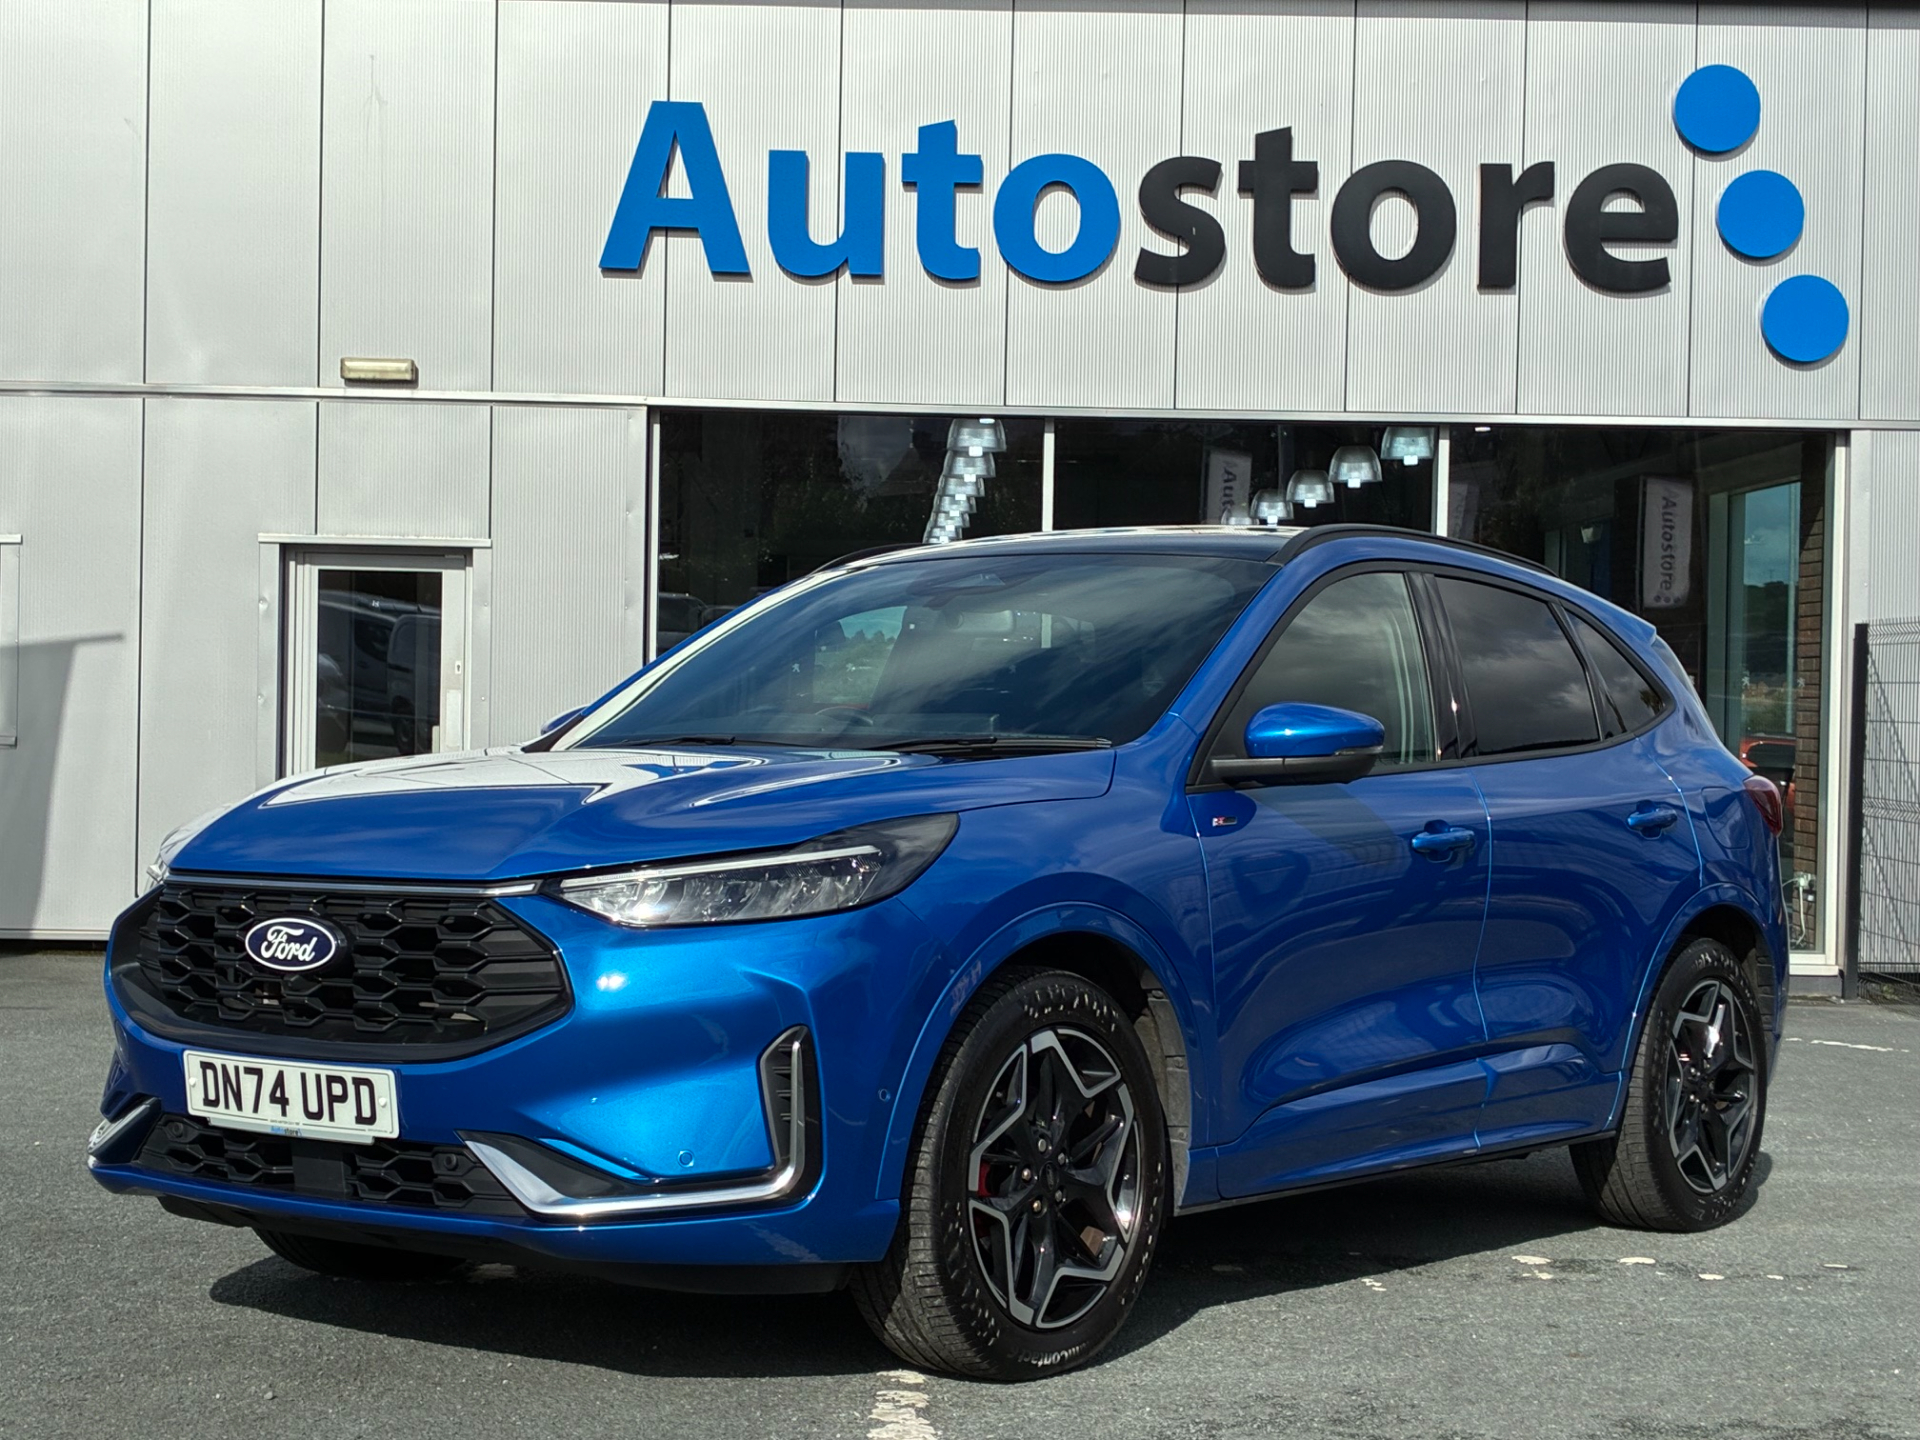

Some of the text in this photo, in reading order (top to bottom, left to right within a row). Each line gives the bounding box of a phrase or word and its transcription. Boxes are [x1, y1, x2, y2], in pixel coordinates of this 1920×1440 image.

[599, 100, 1680, 293] Autostore
[1658, 496, 1677, 591] Autostore
[260, 925, 318, 962] Ford
[199, 1060, 378, 1126] DN74 UPD
